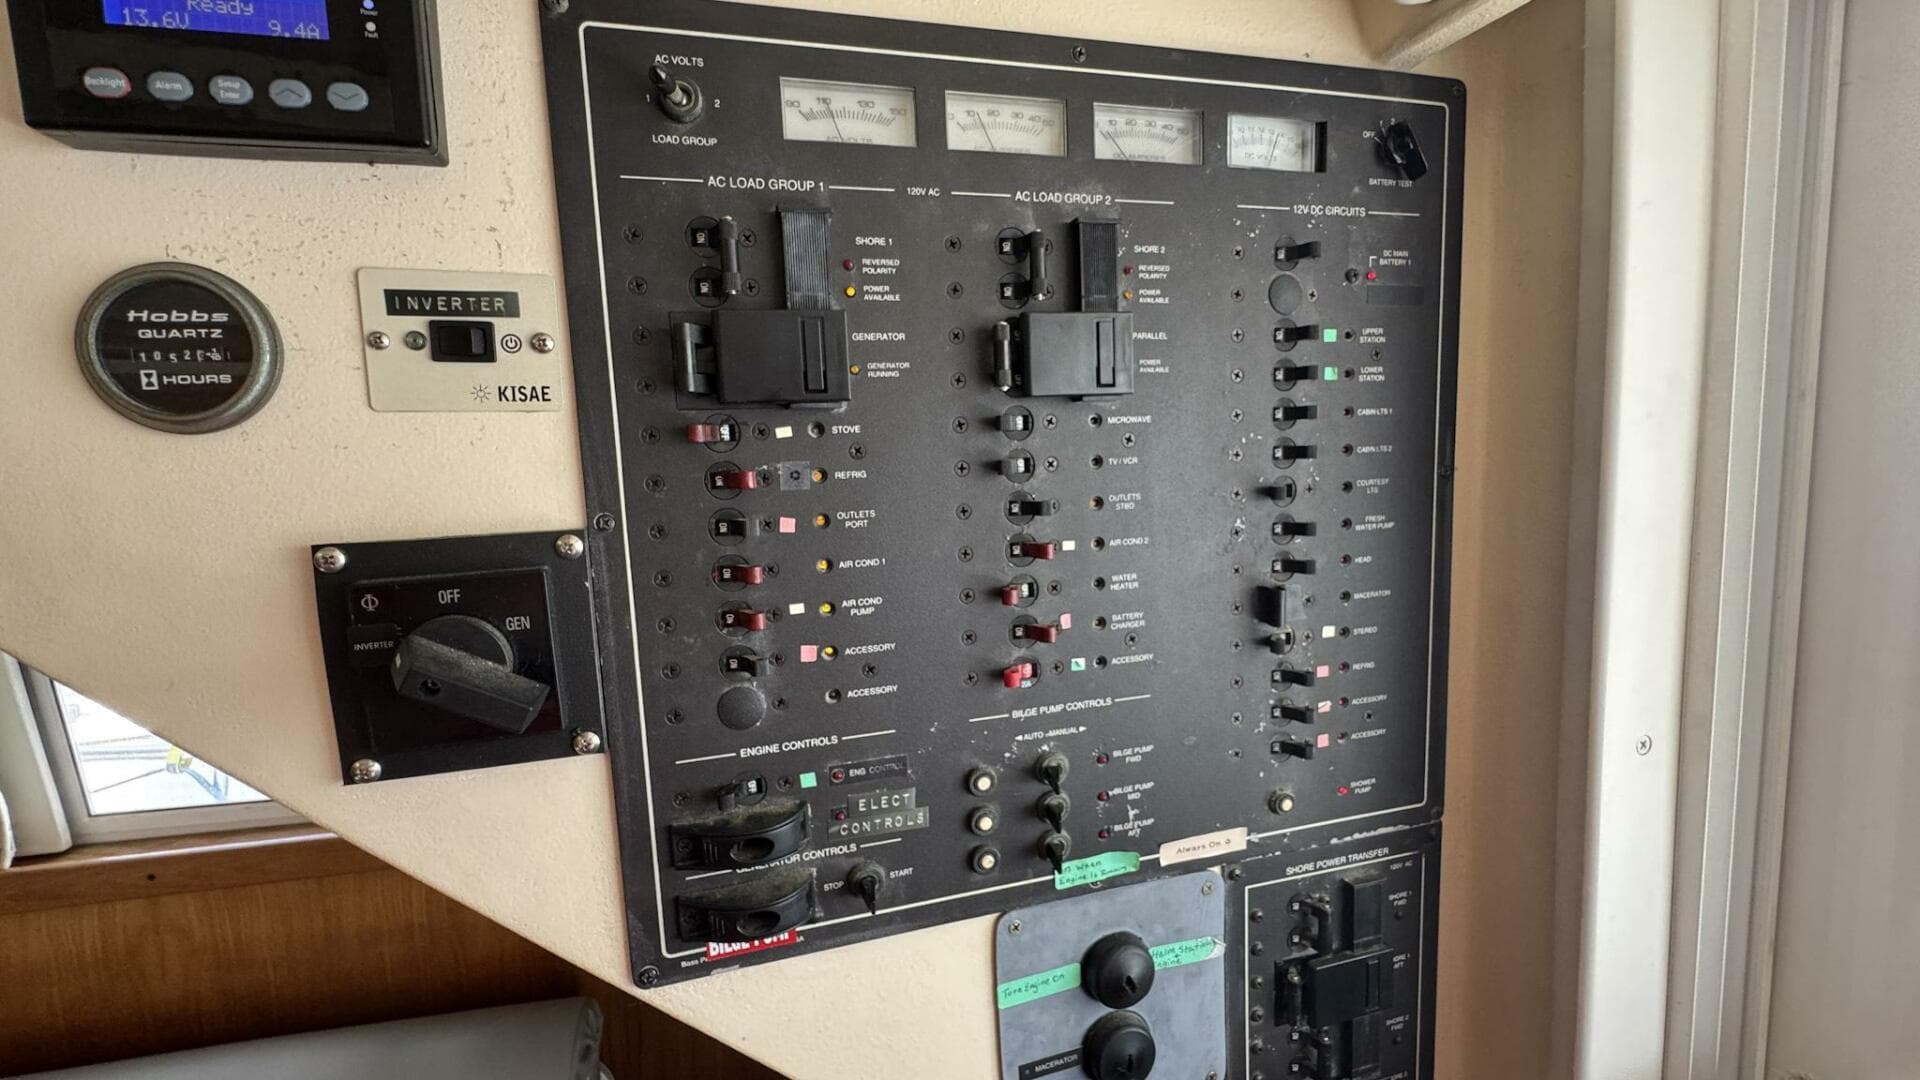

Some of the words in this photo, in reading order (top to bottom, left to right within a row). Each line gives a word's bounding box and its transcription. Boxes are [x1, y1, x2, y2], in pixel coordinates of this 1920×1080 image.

[187, 0, 254, 16] Ready
[122, 8, 189, 30] 13.6V
[268, 20, 320, 40] 9.4A
[655, 54, 669, 65] AC
[671, 55, 704, 67] VOLTS
[85, 76, 126, 89] Backlight
[155, 80, 183, 91] Alarm
[218, 79, 241, 90] Setup
[220, 89, 240, 100] Enter
[714, 99, 721, 108] 2
[1363, 131, 1376, 139] OFF
[652, 134, 680, 145] LOAD
[682, 135, 717, 147] GROUP
[707, 176, 727, 188] AC
[729, 177, 765, 190] LOAD
[768, 179, 816, 192] GROUP
[819, 181, 825, 192] 1
[1369, 178, 1396, 187] BATTERY
[1397, 179, 1413, 188] TEST
[907, 187, 927, 196] 120V
[928, 188, 940, 197] AC
[1015, 191, 1031, 202] AC
[1033, 192, 1063, 203] LOAD
[1065, 193, 1102, 205] GROUP
[1104, 195, 1112, 205] 2
[1293, 205, 1309, 215] 12V
[1311, 206, 1324, 215] DC
[1325, 207, 1366, 217] CIRCUITS
[856, 237, 886, 246] SHORE
[888, 238, 893, 246] 1
[1134, 245, 1159, 254] SHORE
[1160, 246, 1166, 254] 2
[862, 258, 900, 266] REVERSED
[1380, 258, 1407, 266] BATTERY
[862, 267, 897, 275] POLARITY
[1139, 265, 1170, 273] REVERSED
[863, 285, 890, 293] POWER
[864, 294, 901, 302] AVAILABLE
[393, 296, 506, 312] INVERTER
[126, 310, 230, 322] Hobbs
[138, 329, 224, 339] QUARTZ
[852, 333, 906, 342] GENERATOR
[1132, 332, 1168, 341] PARALLEL
[1359, 336, 1386, 344] STATION
[867, 362, 911, 370] GENERATOR
[1360, 366, 1384, 374] LOWER
[162, 374, 233, 385] HOURS
[868, 371, 900, 379] RUNNING
[1358, 375, 1385, 383] STATION
[497, 385, 552, 403] KISAE
[1108, 415, 1152, 425] MICROWAVE
[832, 425, 861, 435] STOVE
[1109, 458, 1118, 466] TV
[1123, 457, 1138, 465] VCR
[835, 470, 868, 480] REFRIG
[1356, 478, 1390, 488] COURTESY
[1109, 493, 1141, 503] OUTLETS
[1115, 502, 1135, 511] STBD
[837, 510, 876, 520] OUTLETS
[1365, 515, 1386, 523] FRESH
[845, 520, 869, 529] PORT
[1355, 523, 1377, 532] WATER
[1110, 539, 1122, 547] AIR
[1122, 537, 1143, 546] COND
[839, 560, 854, 569] AIR
[855, 559, 880, 568] COND
[1355, 556, 1372, 564] HEAD
[1112, 573, 1137, 582] WATER
[1110, 581, 1139, 591] HEATER
[437, 589, 462, 605] OFF
[1354, 590, 1392, 600] MACERATOR
[842, 600, 857, 608] AIR
[858, 597, 883, 607] COND
[850, 607, 876, 617] PUMP
[1112, 612, 1145, 622] BATTERY
[505, 616, 532, 631] GEN
[1111, 620, 1146, 631] CHARGER
[1353, 626, 1378, 636] STEREO
[353, 640, 395, 651] INVERTER
[845, 643, 897, 656] ACCESSORY
[1111, 653, 1154, 665] ACCESSORY
[1353, 662, 1375, 671] REFRIG
[847, 685, 899, 699] ACCESSORY
[1352, 695, 1388, 706] ACCESSORY
[1012, 707, 1038, 719] BILGE
[1040, 704, 1065, 715] PUMP
[1066, 697, 1113, 712] CONTROLS
[1024, 732, 1044, 741] AUTO
[1351, 729, 1387, 740] ACCESSORY
[740, 744, 780, 758] ENGINE
[782, 735, 839, 751] CONTROLS
[1113, 748, 1133, 758] BILGE
[1134, 745, 1155, 755] PUMP
[1126, 755, 1142, 764] FWD
[849, 767, 867, 778] ENG
[1113, 785, 1134, 796] BILGE
[1134, 781, 1155, 791] PUMP
[1350, 778, 1377, 789] SHOWER
[1354, 786, 1373, 795] PUMP
[1127, 792, 1141, 801] MID
[858, 793, 911, 812] ELECT
[840, 812, 925, 836] CONTROLS
[1114, 822, 1134, 832] BILGE
[1134, 818, 1155, 828] PUMP
[1128, 828, 1141, 838] AFT
[802, 843, 858, 861] CONTROLS
[1075, 860, 1103, 872] When
[1286, 863, 1315, 876] SHORE
[1316, 856, 1348, 870] POWER
[1348, 847, 1390, 863] TRANSFER
[890, 867, 914, 879] START
[1059, 872, 1087, 886] Engine
[824, 881, 845, 892] STOP
[1157, 957, 1182, 969] ngine
[1024, 978, 1051, 994] Engine
[1052, 974, 1065, 984] On
[1035, 1054, 1079, 1073] MACERATOR
